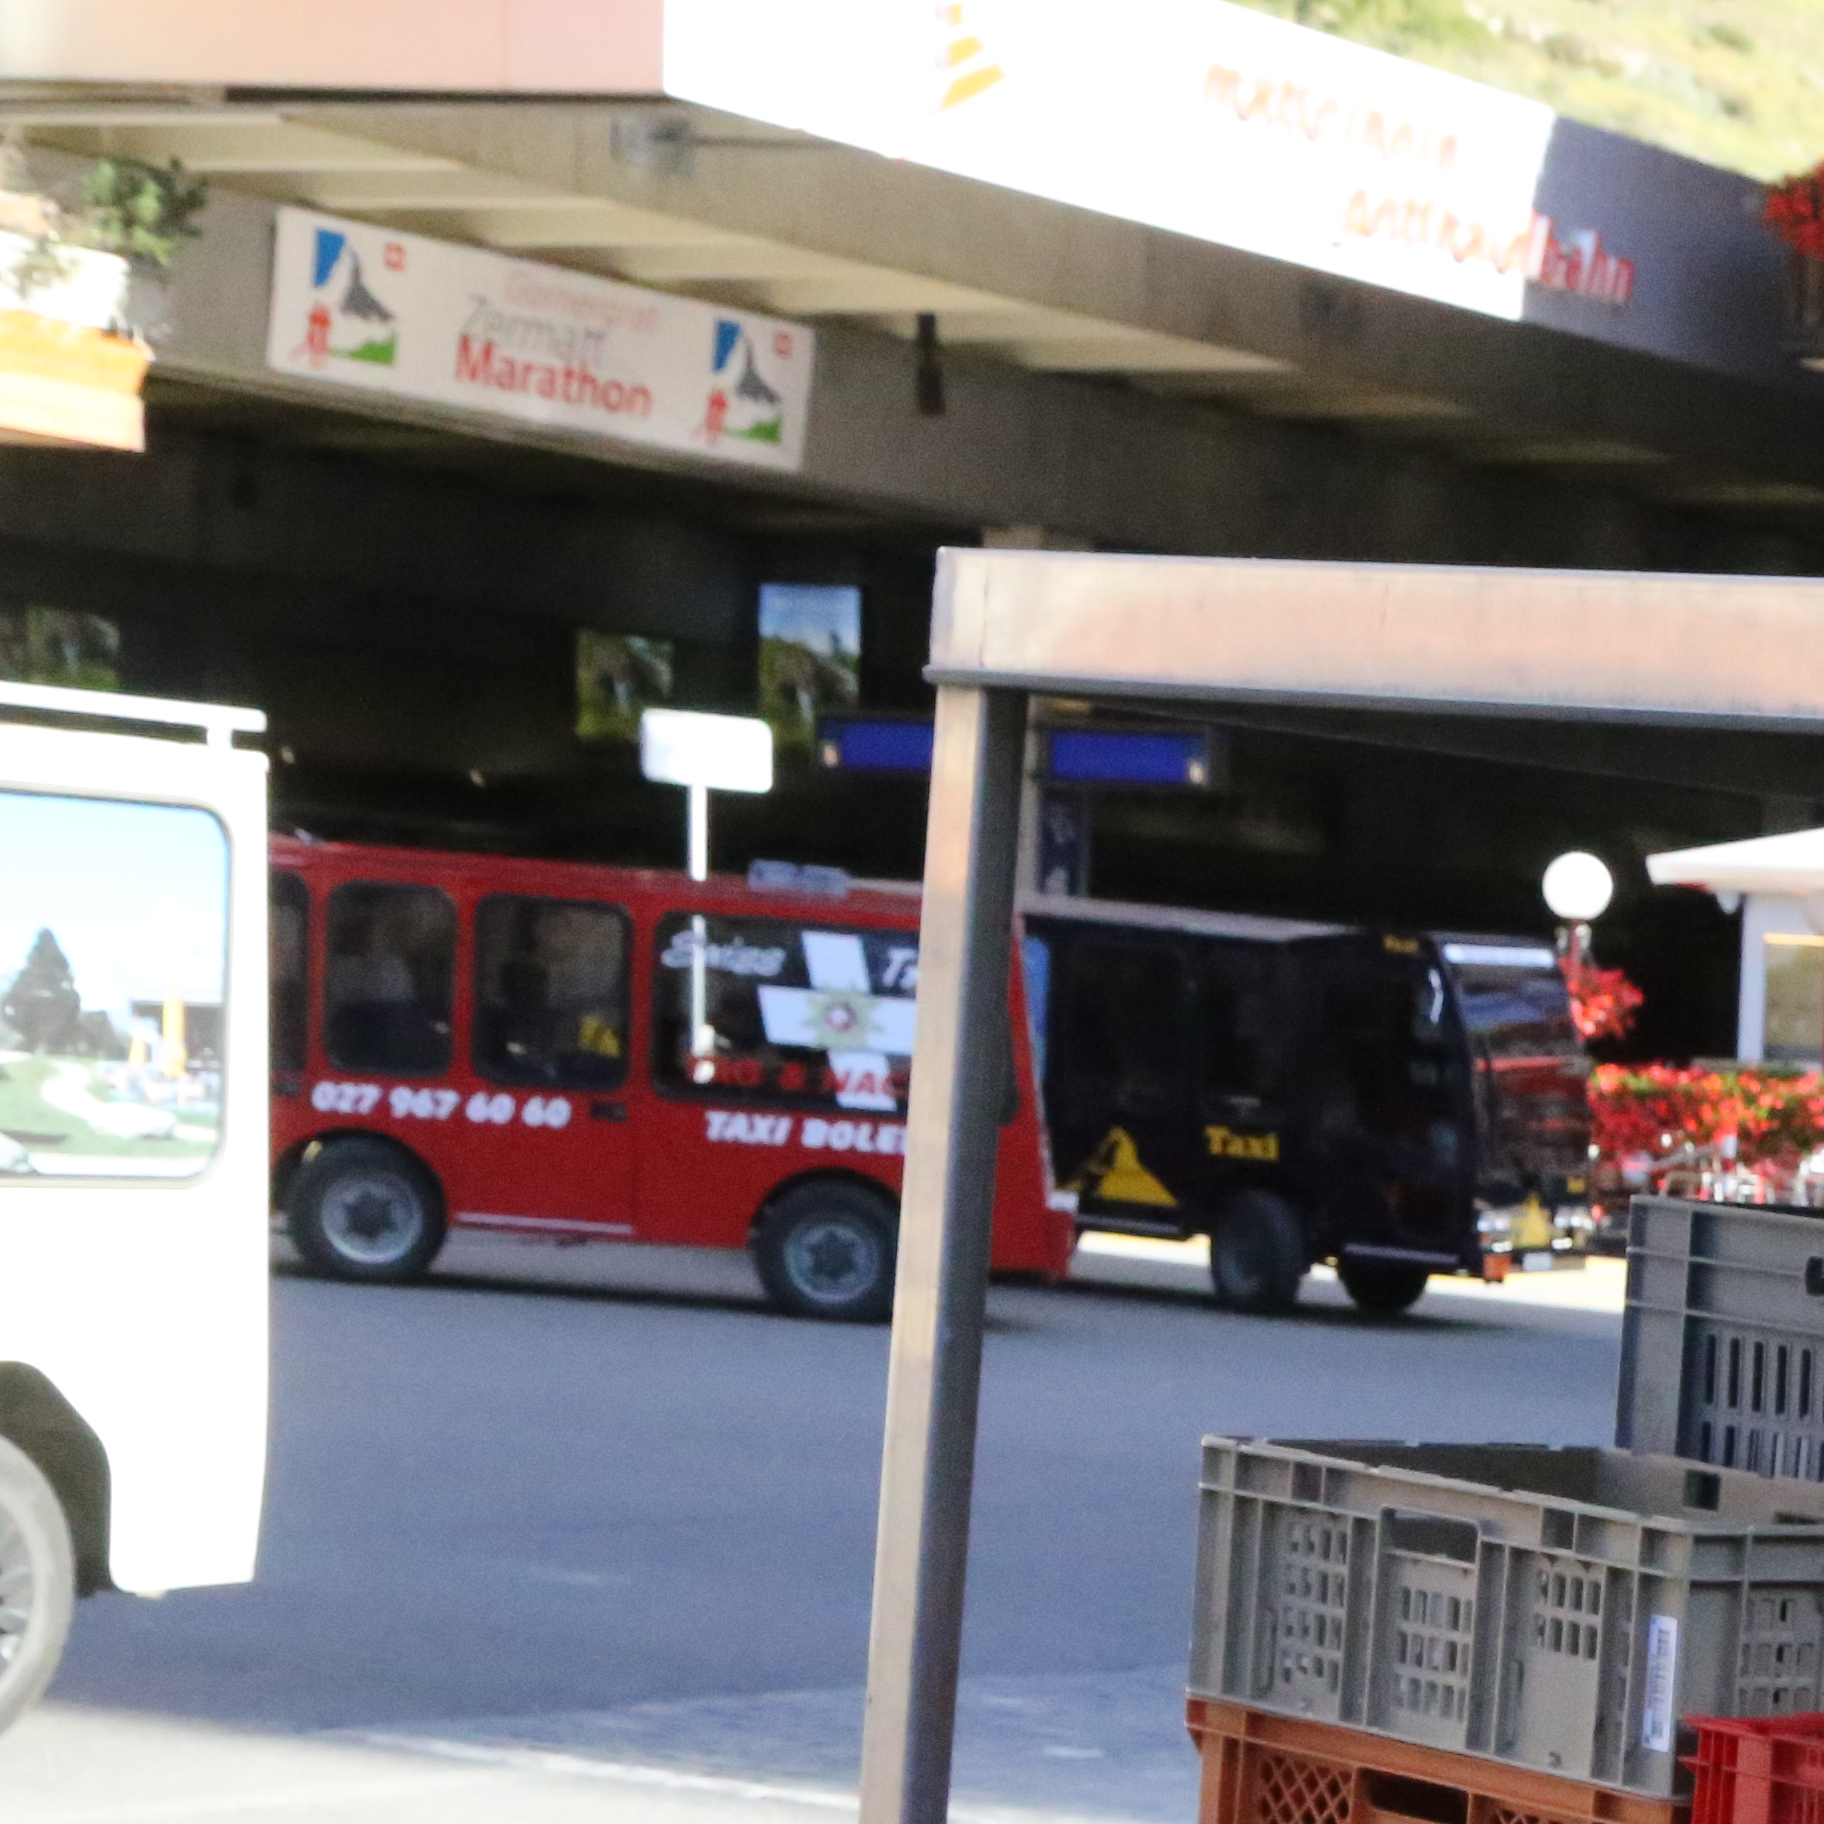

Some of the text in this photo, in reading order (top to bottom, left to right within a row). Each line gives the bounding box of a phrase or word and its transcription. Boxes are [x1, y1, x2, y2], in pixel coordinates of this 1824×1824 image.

[455, 333, 654, 418] Marathon
[311, 1080, 381, 1115] 027
[465, 1092, 516, 1124] 60
[521, 1096, 572, 1129] 60
[705, 1110, 793, 1147] TAXI
[1205, 1124, 1279, 1162] Taxi
